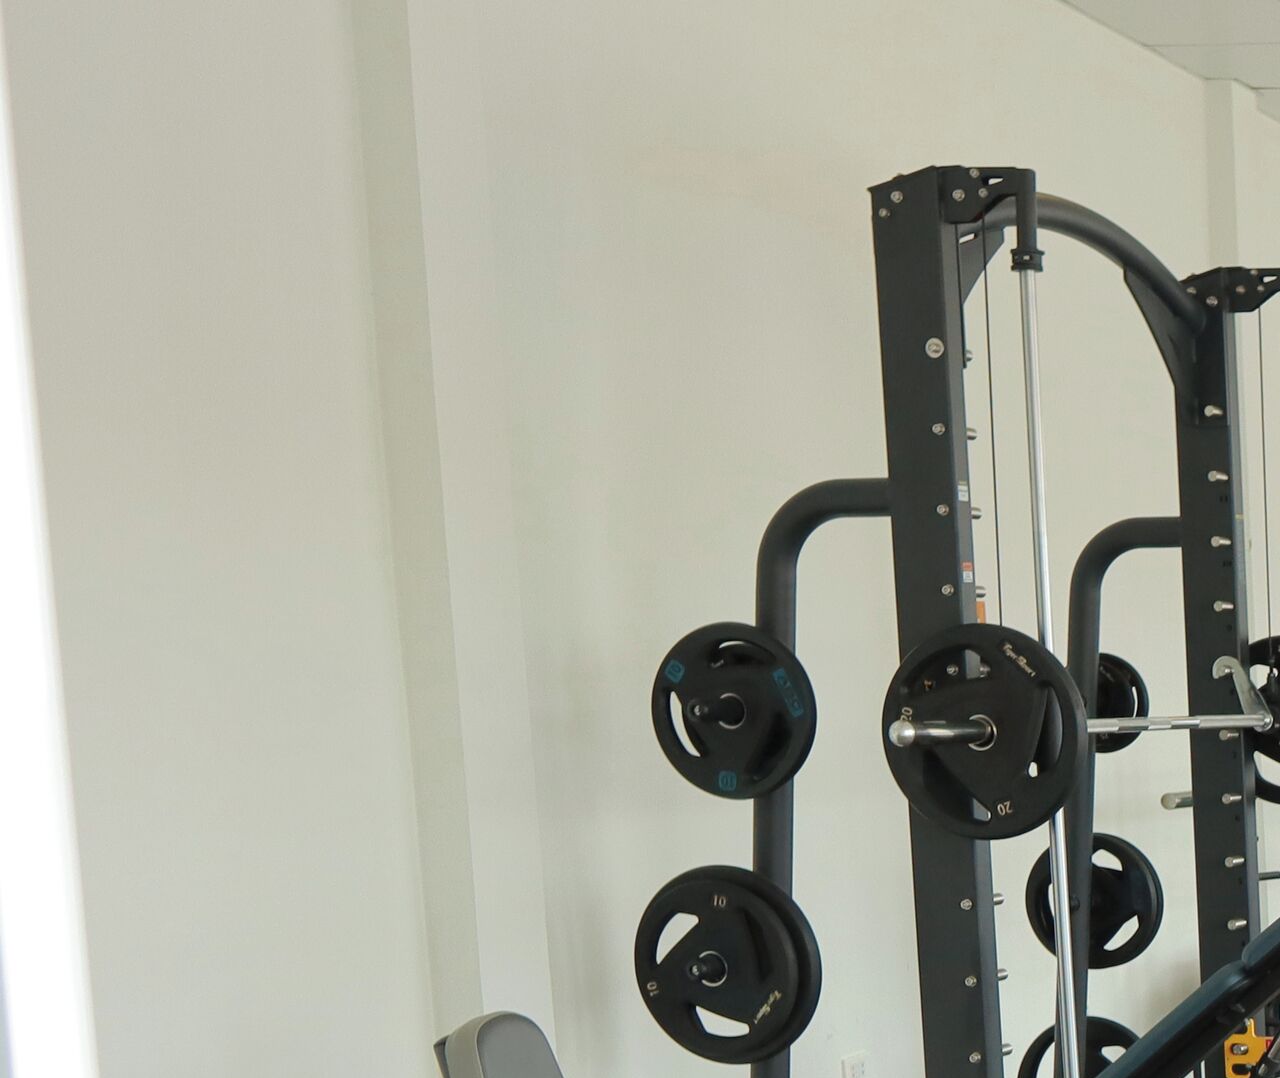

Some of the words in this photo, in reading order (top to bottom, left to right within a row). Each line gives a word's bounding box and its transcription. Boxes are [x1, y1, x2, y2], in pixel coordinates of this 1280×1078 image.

[997, 800, 1013, 817] 20
[712, 894, 727, 908] 10
[646, 980, 660, 997] 10
